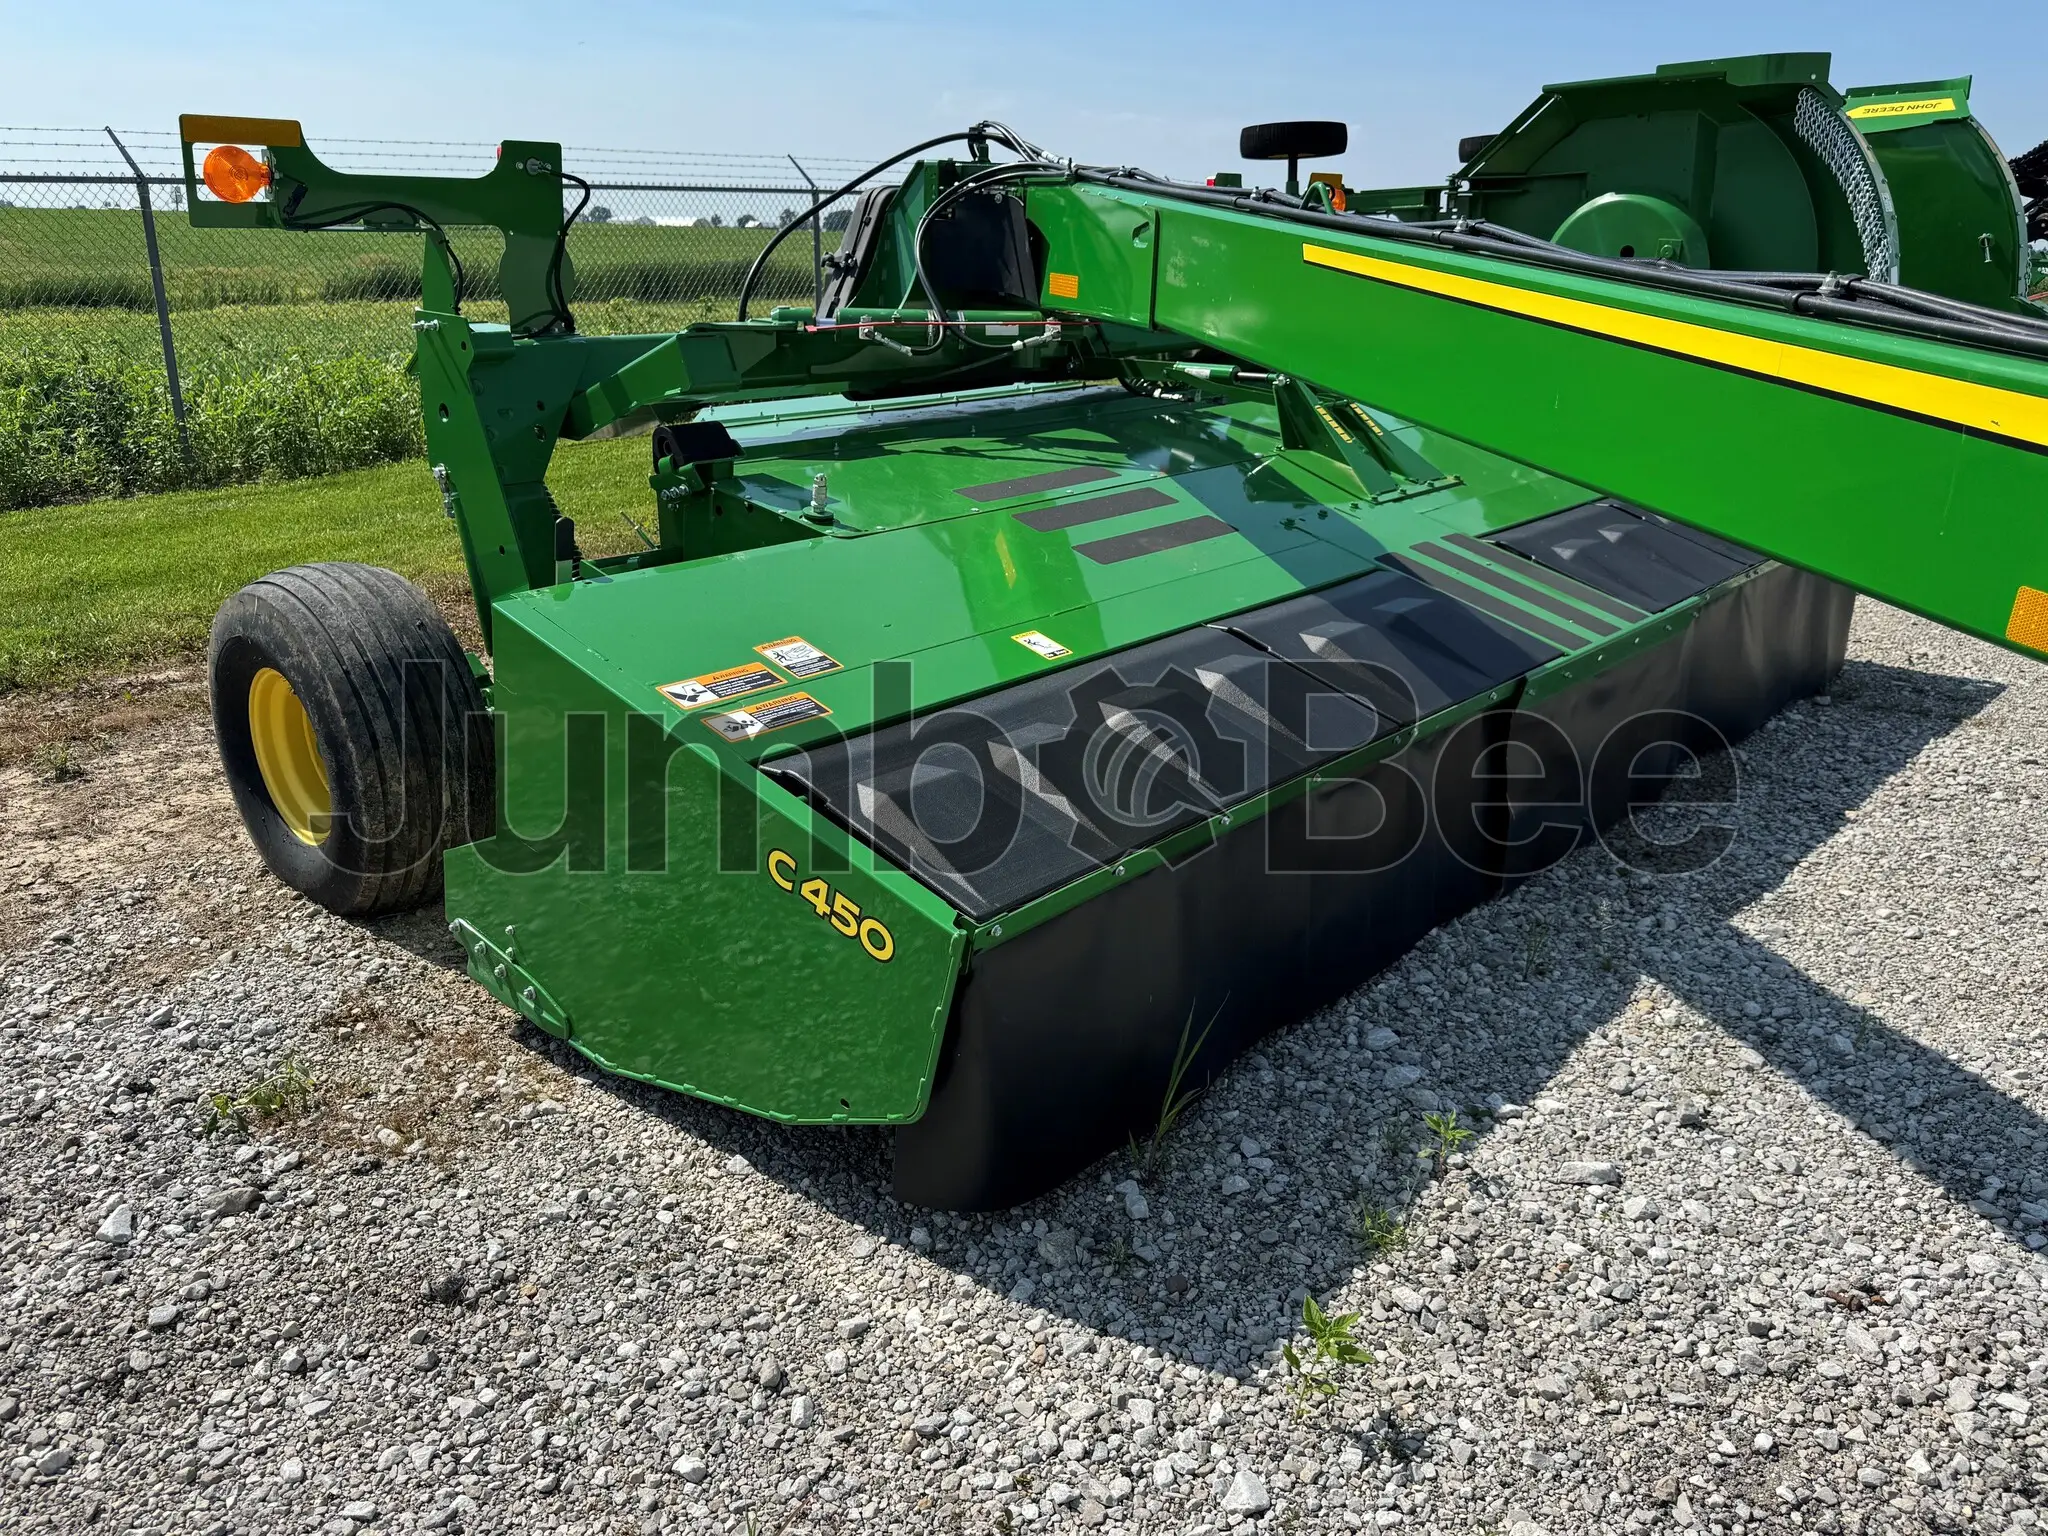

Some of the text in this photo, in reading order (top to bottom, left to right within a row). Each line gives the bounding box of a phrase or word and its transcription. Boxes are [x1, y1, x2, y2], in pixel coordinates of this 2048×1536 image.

[1864, 106, 1904, 114] DEERE
[762, 696, 797, 708] WARNING
[767, 848, 895, 963] C 450
